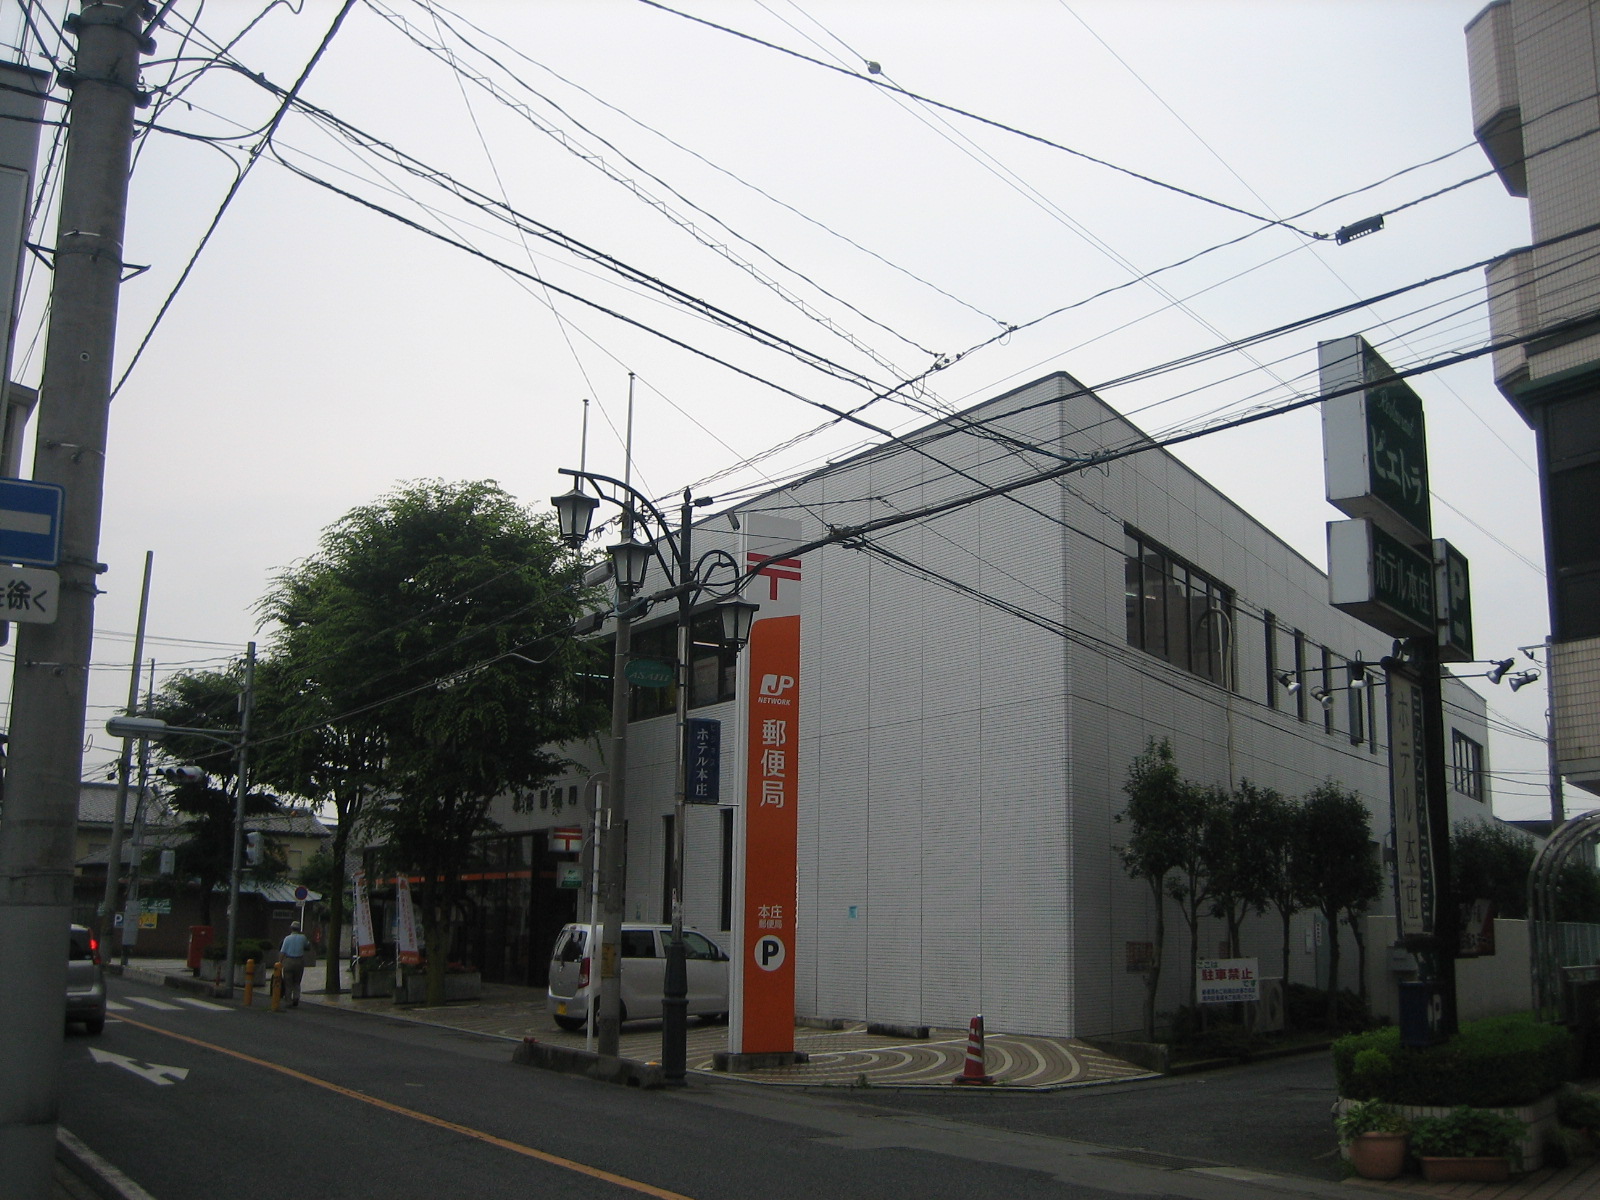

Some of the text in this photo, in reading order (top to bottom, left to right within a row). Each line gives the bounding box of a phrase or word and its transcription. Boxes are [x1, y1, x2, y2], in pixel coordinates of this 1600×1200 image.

[1371, 424, 1422, 506] ピエトラ
[1375, 543, 1430, 615] ホテル本庄
[1449, 555, 1466, 610] P
[757, 696, 792, 706] NETWORK
[695, 728, 709, 796] ホテル本庄
[760, 718, 787, 808] 郵便局
[1397, 690, 1417, 920] ホテル本庄
[114, 914, 123, 926] P
[757, 904, 783, 919] 本庄
[763, 940, 780, 966] P
[1197, 961, 1218, 969] ここは
[1202, 968, 1254, 980] 駐車禁止
